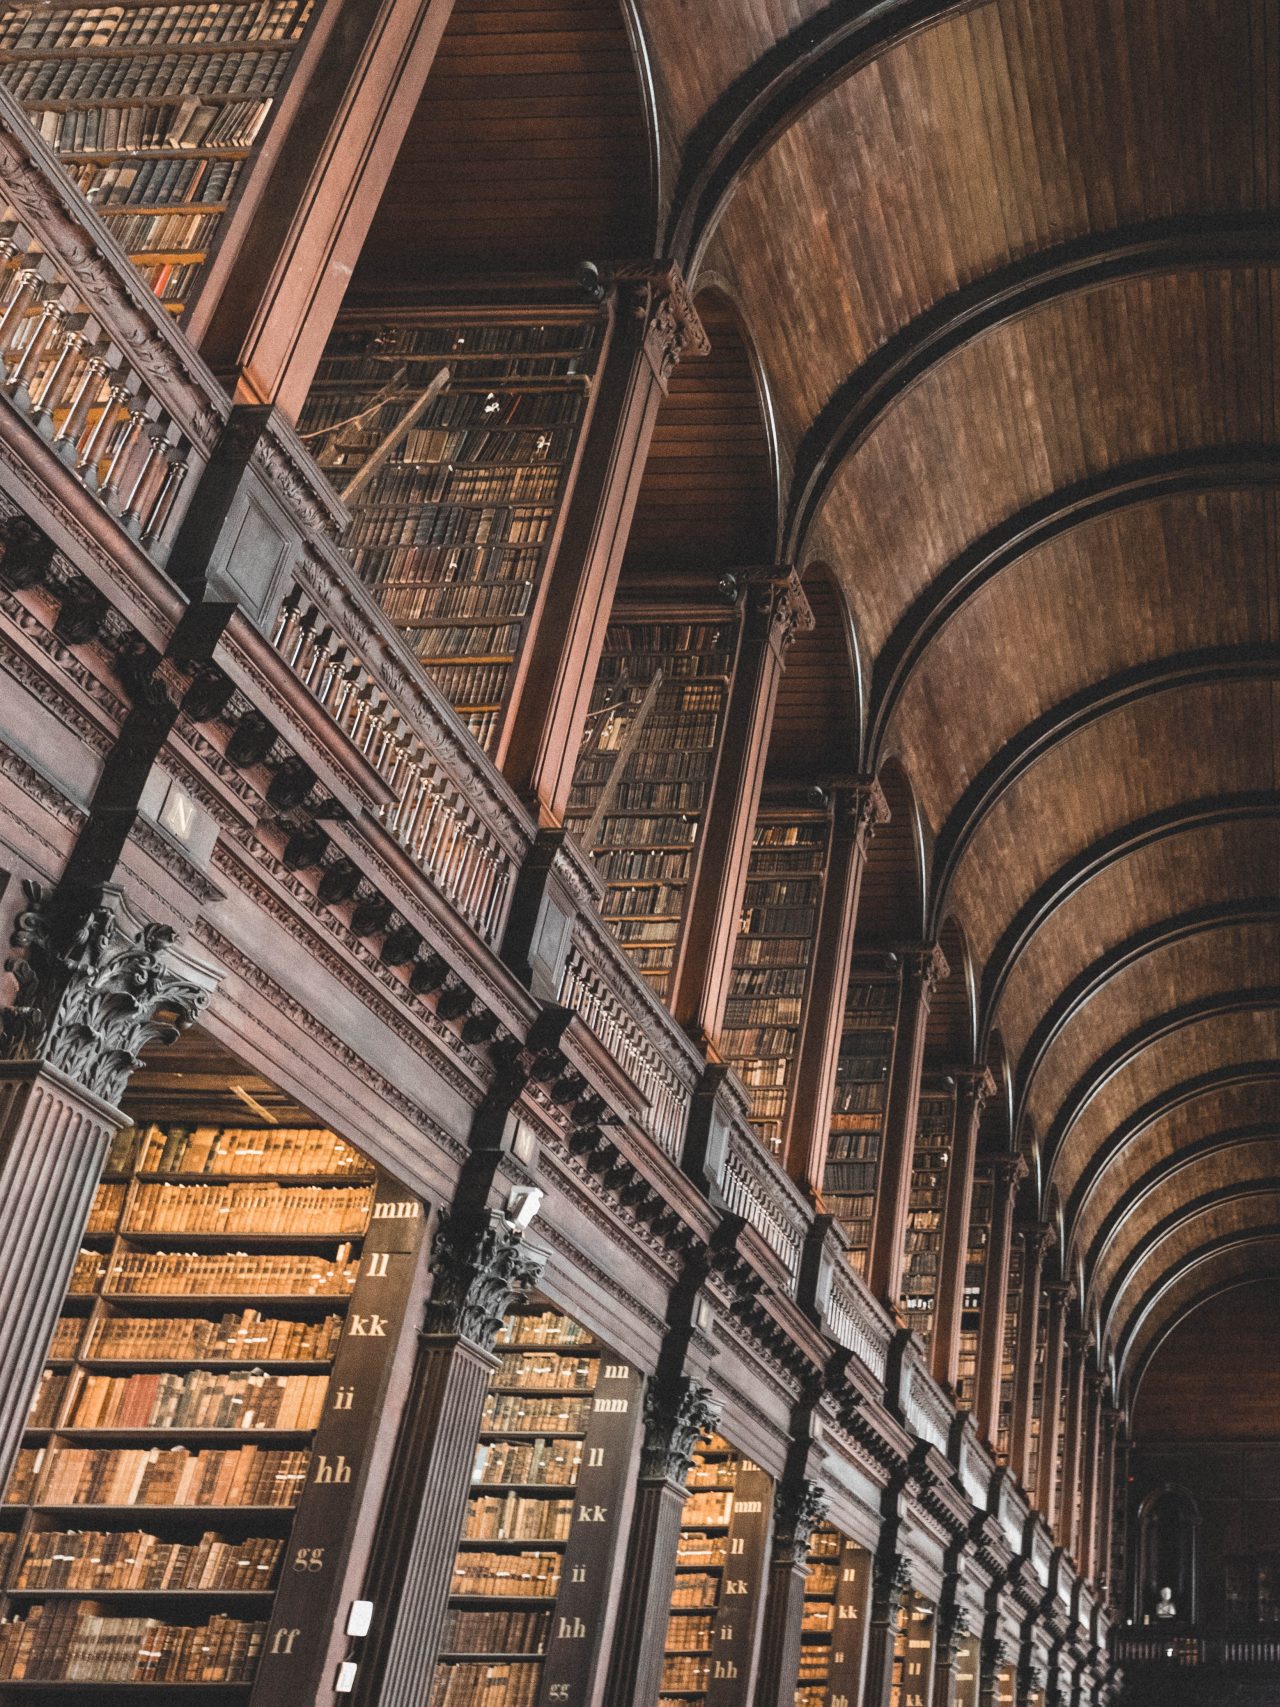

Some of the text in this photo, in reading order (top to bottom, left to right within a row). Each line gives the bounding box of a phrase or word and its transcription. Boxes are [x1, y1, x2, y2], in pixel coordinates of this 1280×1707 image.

[168, 795, 194, 834] N
[373, 1202, 419, 1219] mm
[366, 1253, 389, 1276] ll
[349, 1315, 388, 1336] kk
[604, 1366, 629, 1378] nn
[334, 1387, 354, 1409] ii
[594, 1399, 628, 1412] mm
[588, 1448, 604, 1466] ll
[314, 1456, 351, 1483] hh
[578, 1506, 607, 1521] kk
[734, 1502, 761, 1512] mm
[731, 1539, 744, 1554] ll
[294, 1547, 325, 1572] gg
[572, 1565, 585, 1582] ii
[726, 1580, 747, 1594] kk
[839, 1605, 857, 1618] kk
[558, 1617, 585, 1638] hh
[721, 1625, 732, 1639] ii
[271, 1628, 300, 1653] ff
[714, 1661, 737, 1678] hh
[549, 1683, 570, 1700] gg
